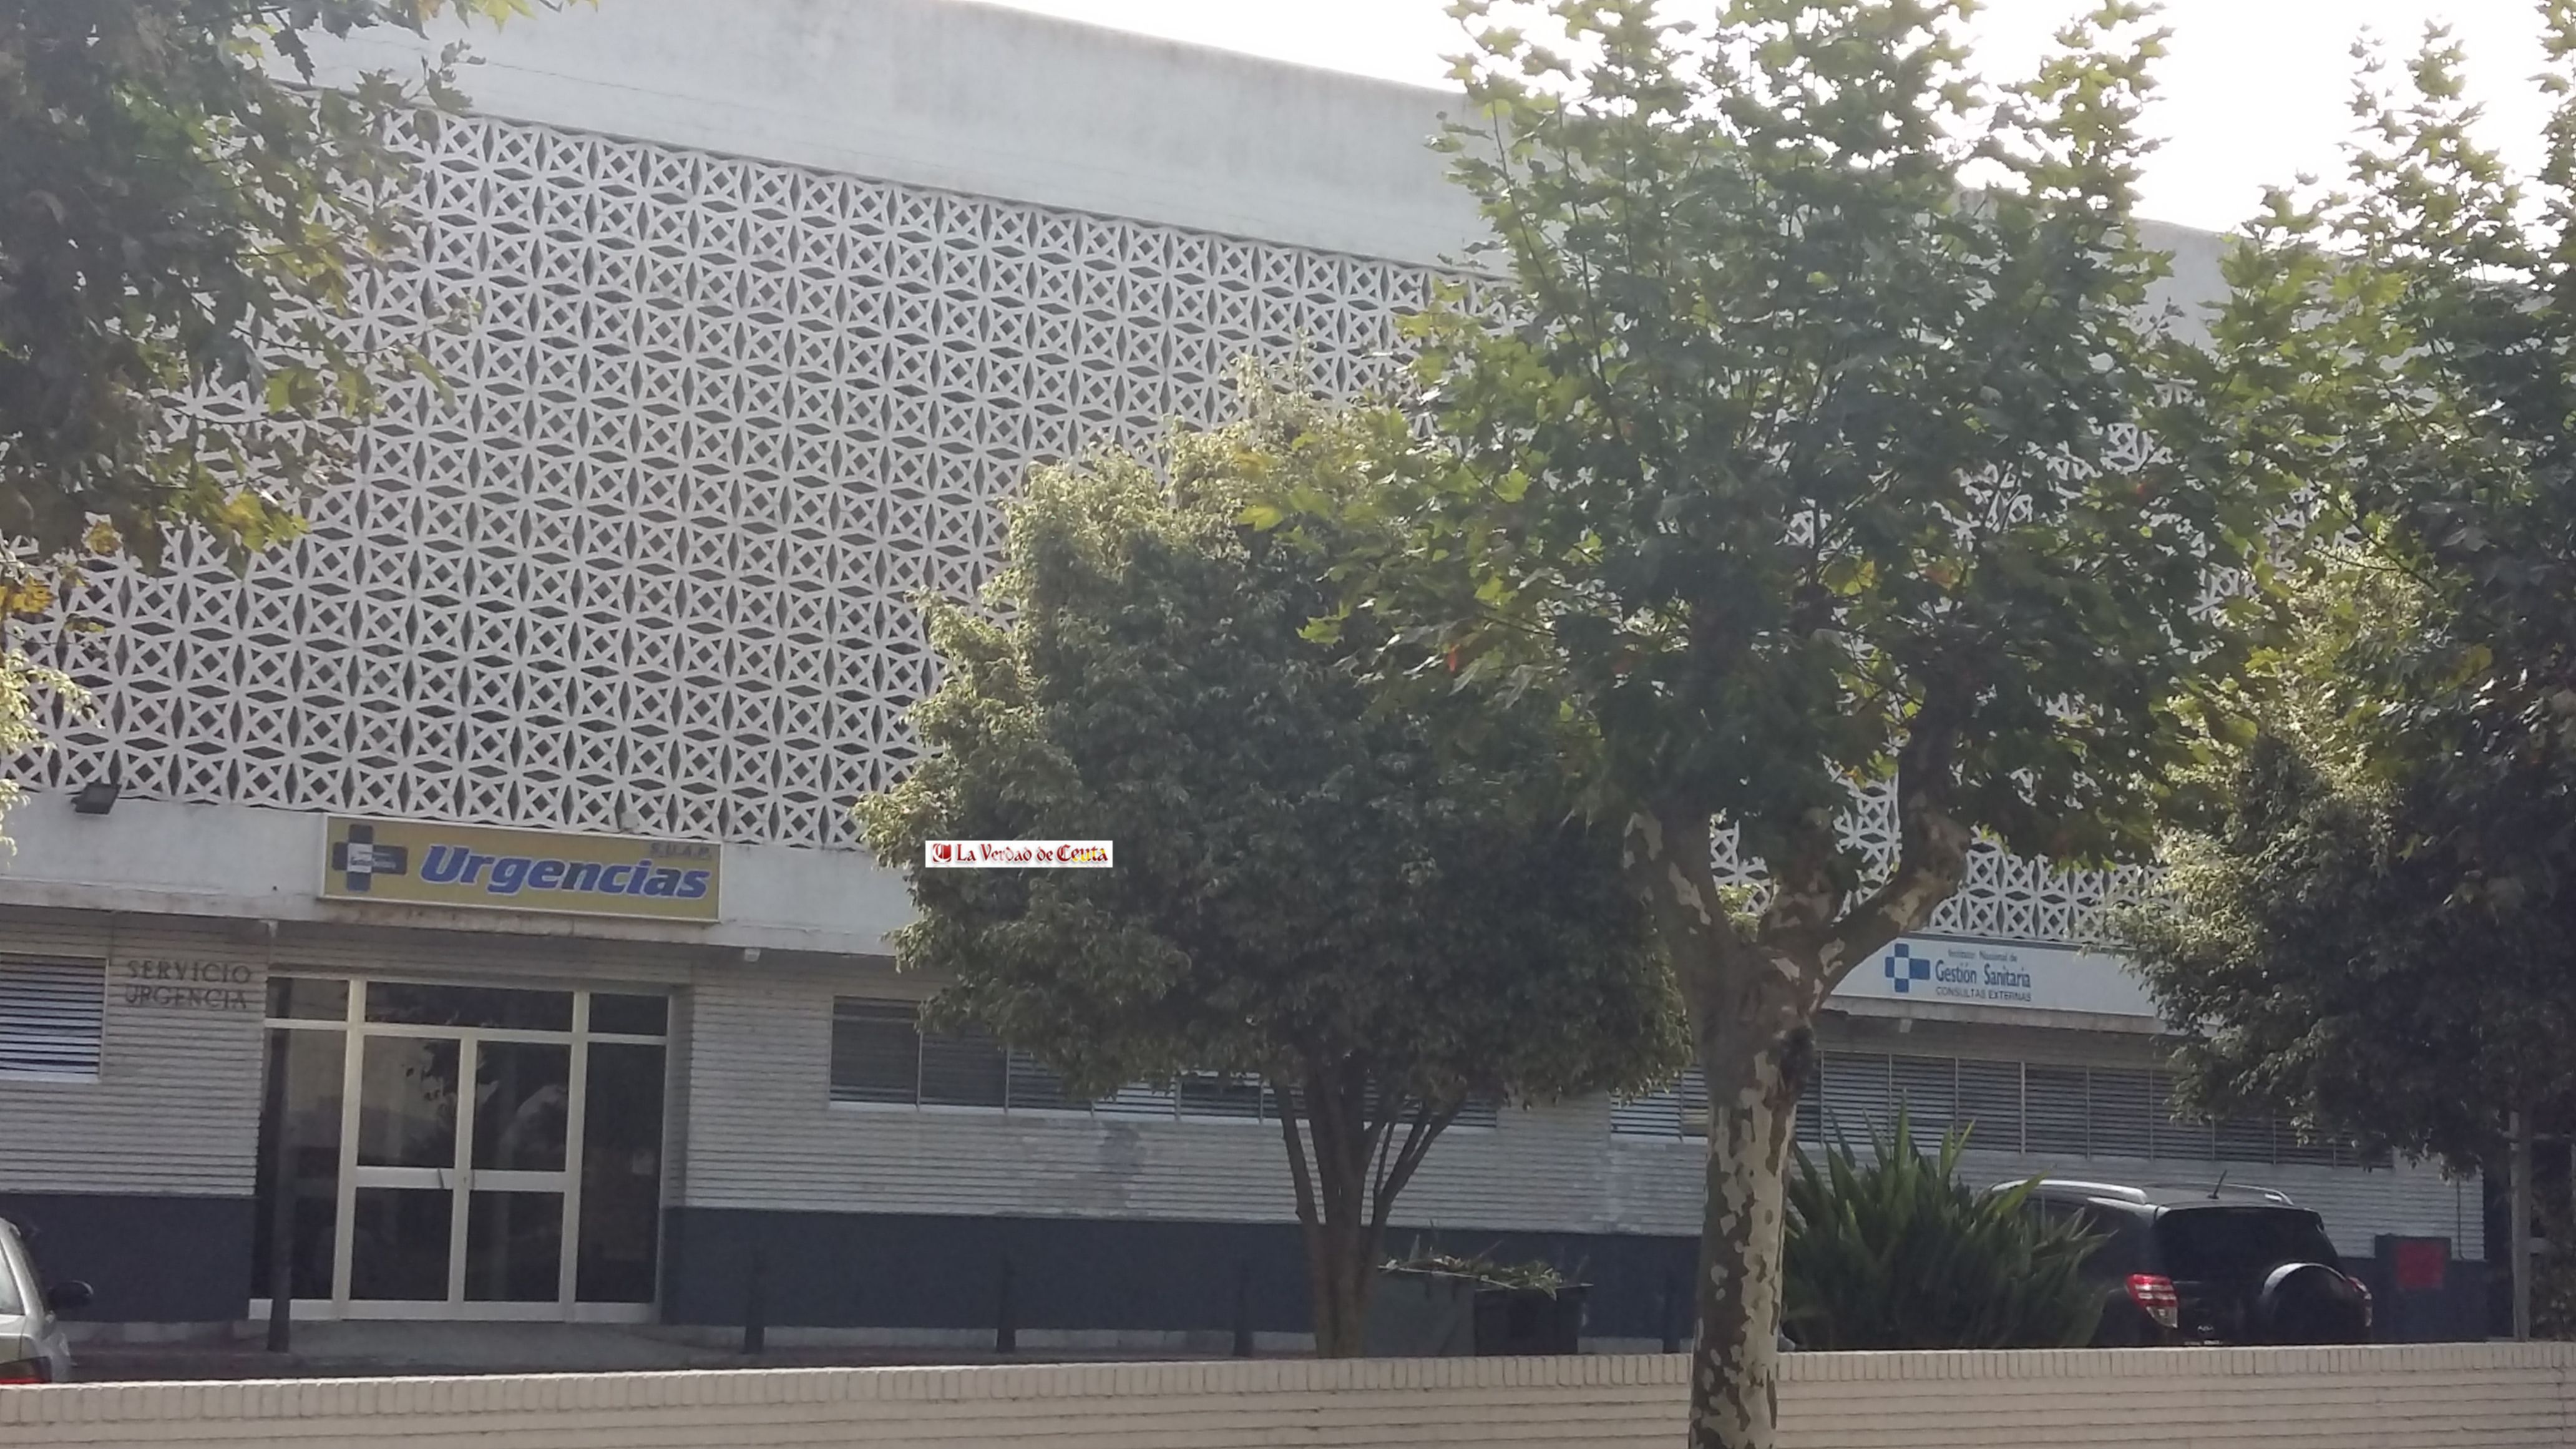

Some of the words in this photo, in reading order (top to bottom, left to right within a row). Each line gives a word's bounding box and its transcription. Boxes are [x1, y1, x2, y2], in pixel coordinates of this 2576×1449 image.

[420, 844, 711, 899] Urgencias
[128, 960, 250, 983] SERVICIO
[1935, 959, 1977, 984] Gestión
[1984, 963, 2031, 988] Sanitaria
[126, 985, 246, 1009] URGENCIA
[1936, 986, 1986, 998] CONSULTAS
[1989, 990, 2031, 1002] EXTERNAS
